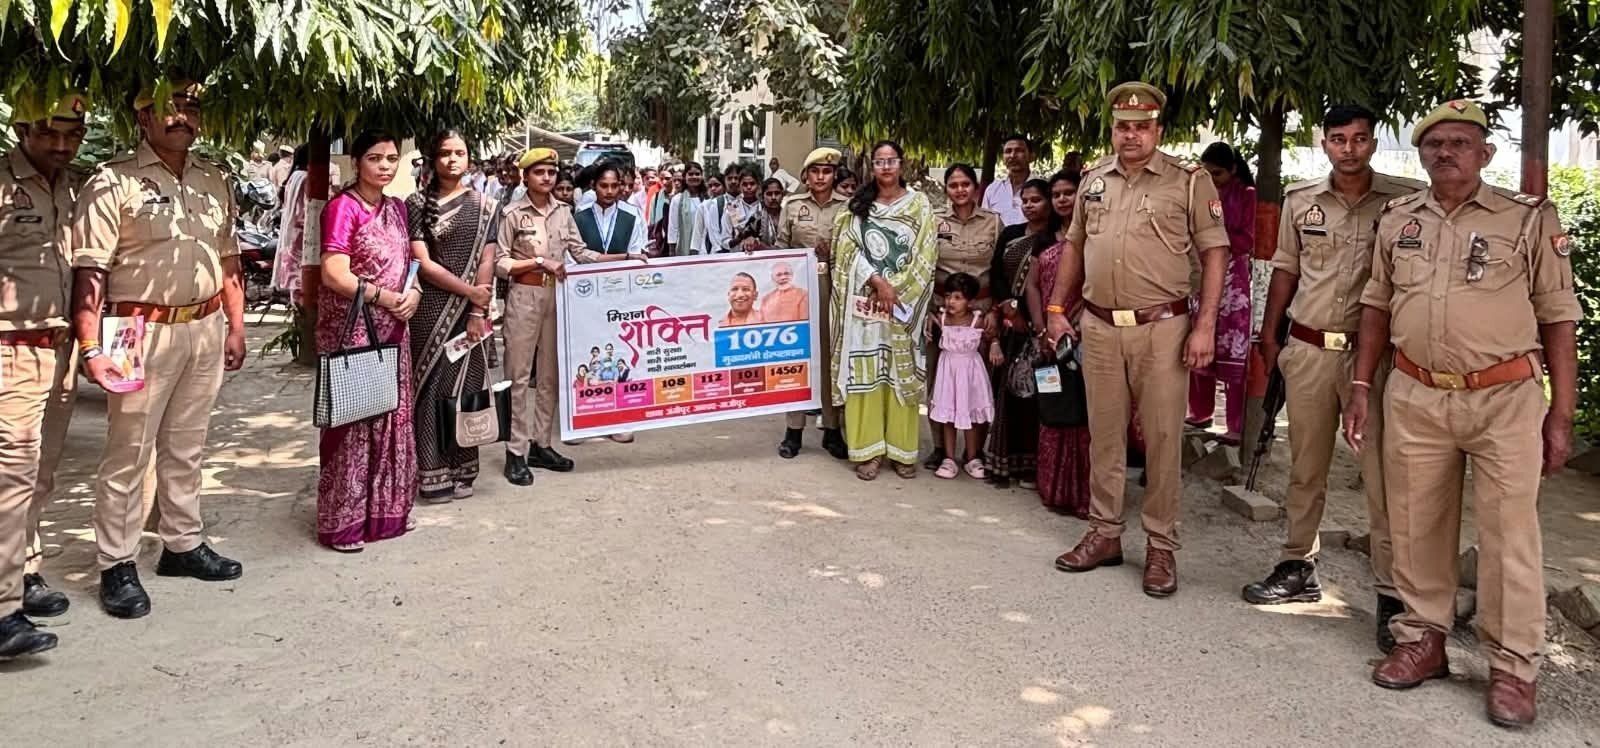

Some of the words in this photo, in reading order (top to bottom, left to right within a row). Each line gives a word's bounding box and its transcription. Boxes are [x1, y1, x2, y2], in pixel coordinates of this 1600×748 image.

[607, 309, 645, 322] मिशन
[618, 305, 712, 368] शक्ति
[728, 326, 799, 350] 1076
[738, 369, 759, 379] 101
[770, 365, 804, 376] 14567
[662, 377, 686, 388] 108
[701, 373, 723, 383] 112
[579, 386, 613, 398] 1090
[623, 382, 647, 393] 102
